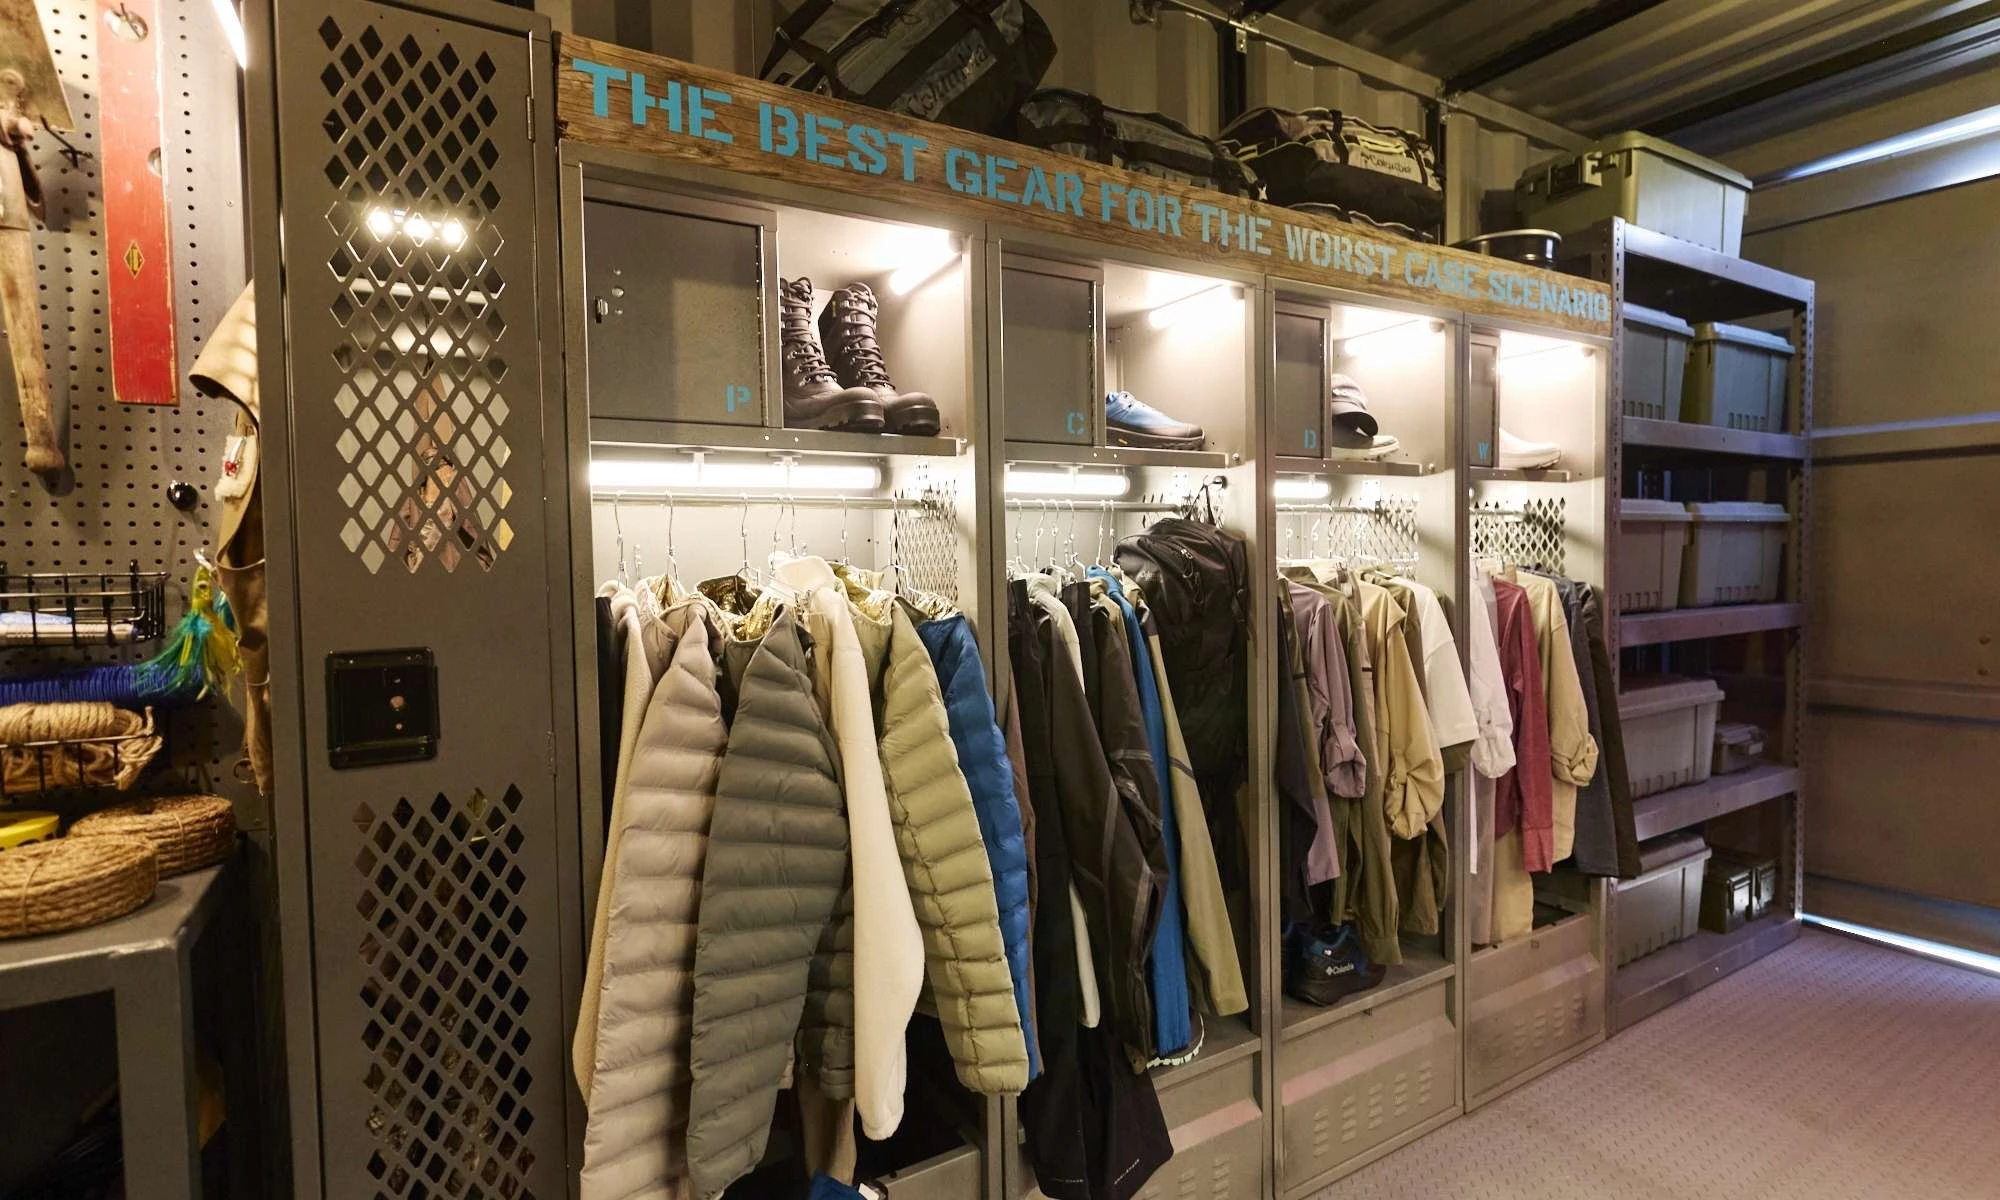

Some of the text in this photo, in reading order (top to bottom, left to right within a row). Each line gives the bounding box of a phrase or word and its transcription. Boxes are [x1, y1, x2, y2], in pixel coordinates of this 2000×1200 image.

[572, 58, 733, 144] THE
[759, 102, 928, 183] BEST
[945, 147, 1084, 217] GEAR
[1101, 181, 1181, 238] FOR
[1193, 203, 1272, 256] THE
[1284, 224, 1396, 281] WORST
[1404, 252, 1481, 299] CASE
[1488, 270, 1609, 322] SCENARIO
[726, 384, 751, 413] P
[1066, 411, 1088, 436] C
[1304, 428, 1316, 449] D
[1478, 441, 1489, 462] W
